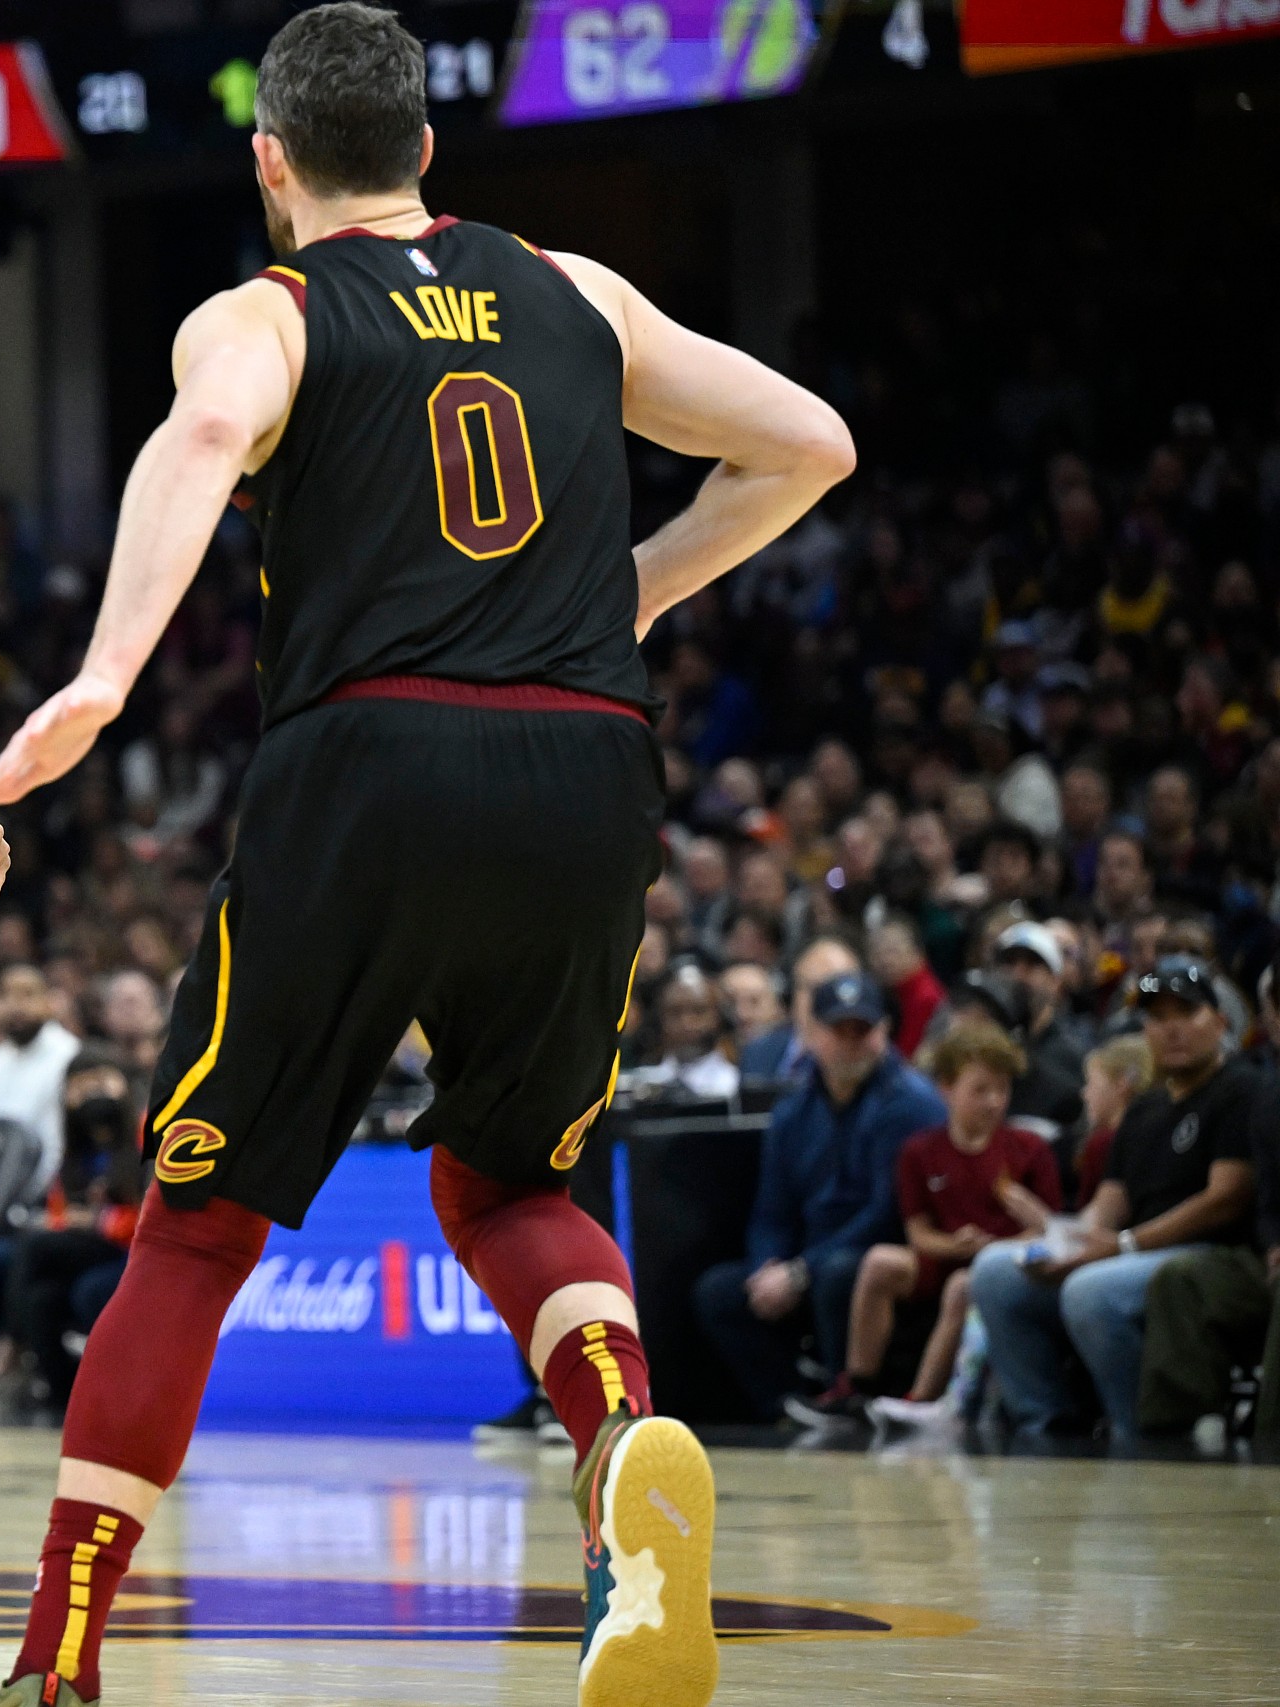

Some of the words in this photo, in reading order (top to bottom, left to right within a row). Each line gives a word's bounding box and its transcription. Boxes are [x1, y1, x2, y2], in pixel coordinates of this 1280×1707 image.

[563, 5, 672, 107] 62
[389, 285, 501, 343] LOVE
[427, 371, 544, 561] 0
[416, 1252, 521, 1336] UL
